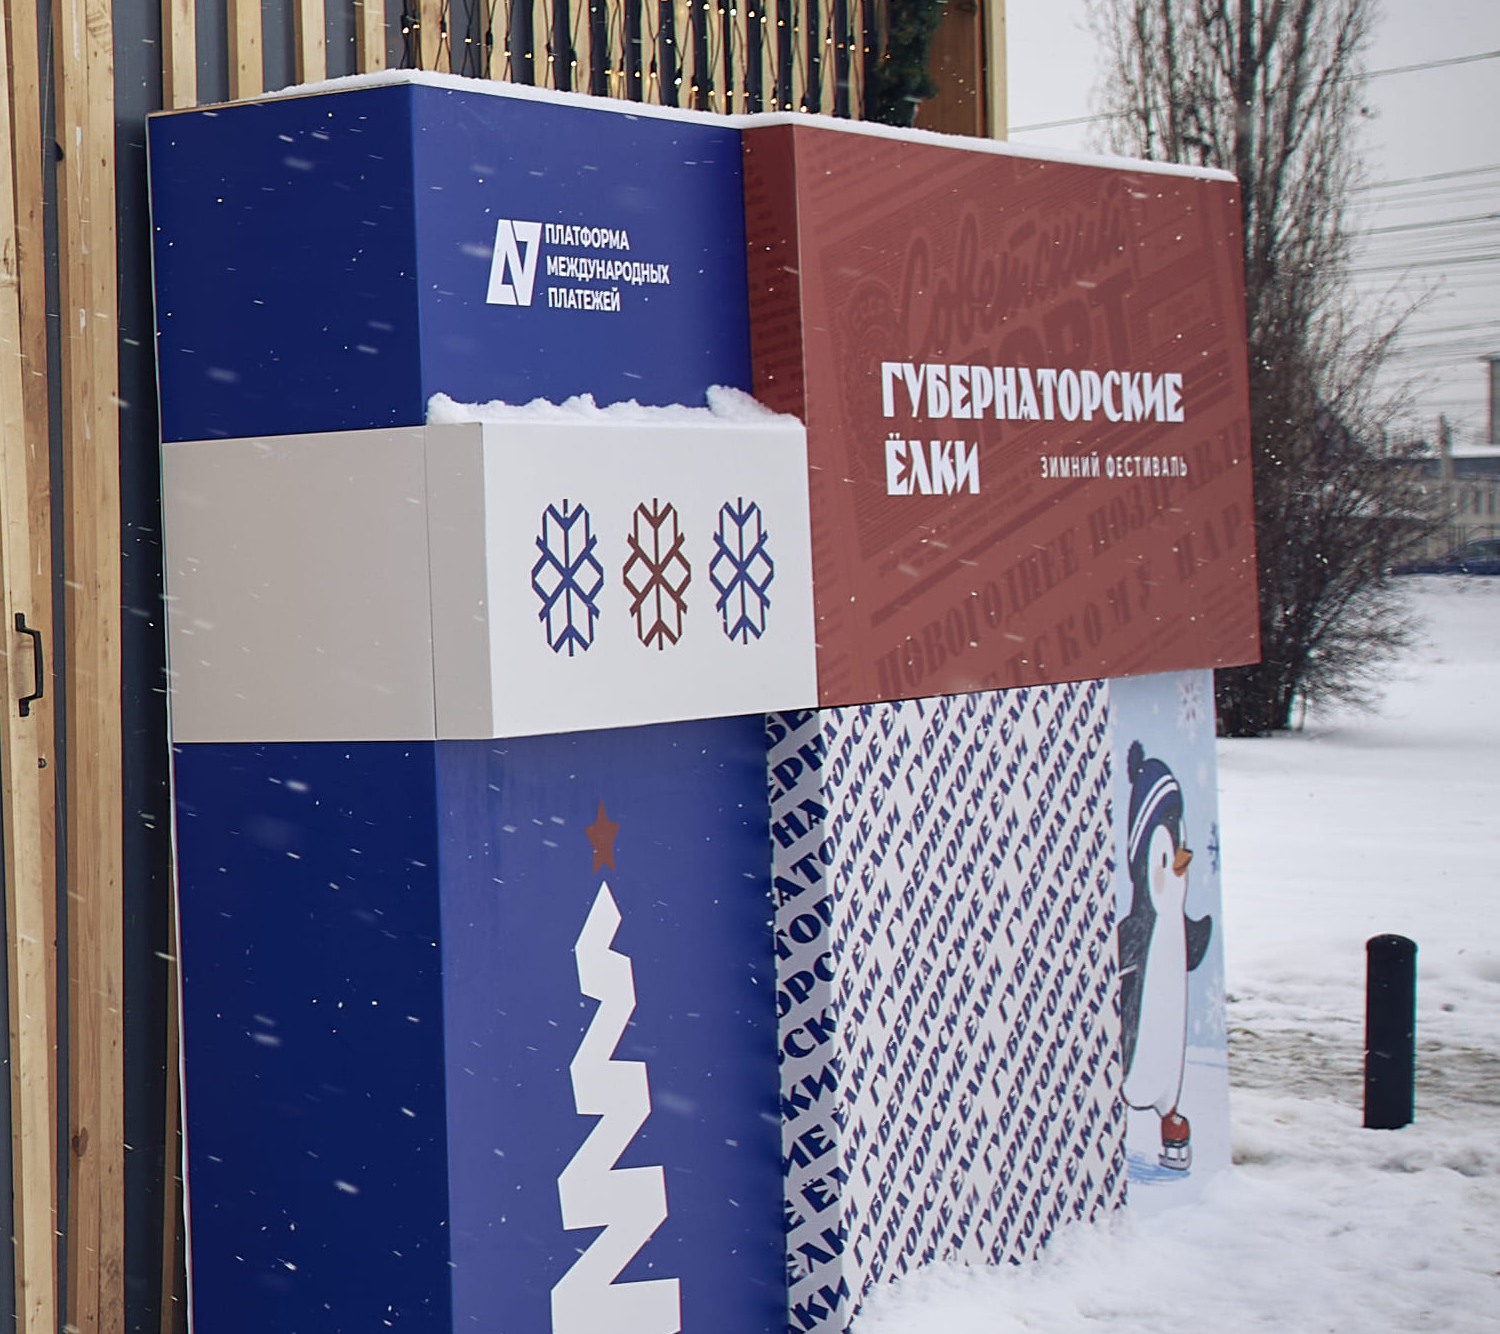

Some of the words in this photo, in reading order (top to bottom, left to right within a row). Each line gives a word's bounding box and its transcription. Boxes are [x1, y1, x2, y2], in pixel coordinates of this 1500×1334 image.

[545, 223, 630, 250] ПЛАТФОРМА
[546, 255, 670, 285] МЕЖДУНАРОДНЫХ
[547, 286, 621, 311] ПЛАТЕЖЕЙ
[881, 361, 1184, 422] ГУБЕРНАТОРСКИЕ
[884, 433, 980, 495] ЁЛКИ
[1040, 450, 1100, 479] ЗИМНИЙ
[1104, 454, 1188, 479] ФЕСТИВАЛЬ
[879, 744, 1001, 1027] ГУБЕРНАТОРСКИЕ
[888, 690, 1003, 949] ГУБЕРНАТОРСКИ
[897, 693, 976, 871] ГУБЕРНАТО
[1000, 751, 1111, 1023] ГУБЕРНАТОРСКИЕ
[863, 891, 983, 1187] ГУБЕРНАТОРСКИЕ
[871, 816, 992, 1107] ГУБЕРНАТОРСКИЕ
[985, 892, 1098, 1173] ГУБЕРНАТОРСКИЕ
[993, 822, 1106, 1098] ГУБЕРНАТОРСКИЕ
[855, 965, 975, 1267] ГУБЕРНАТОРСКИЕ
[977, 964, 1090, 1250] ГУБЕРНАТОРСКИЕ
[987, 1037, 1083, 1266] ЕРНАТОРСКИЕ
